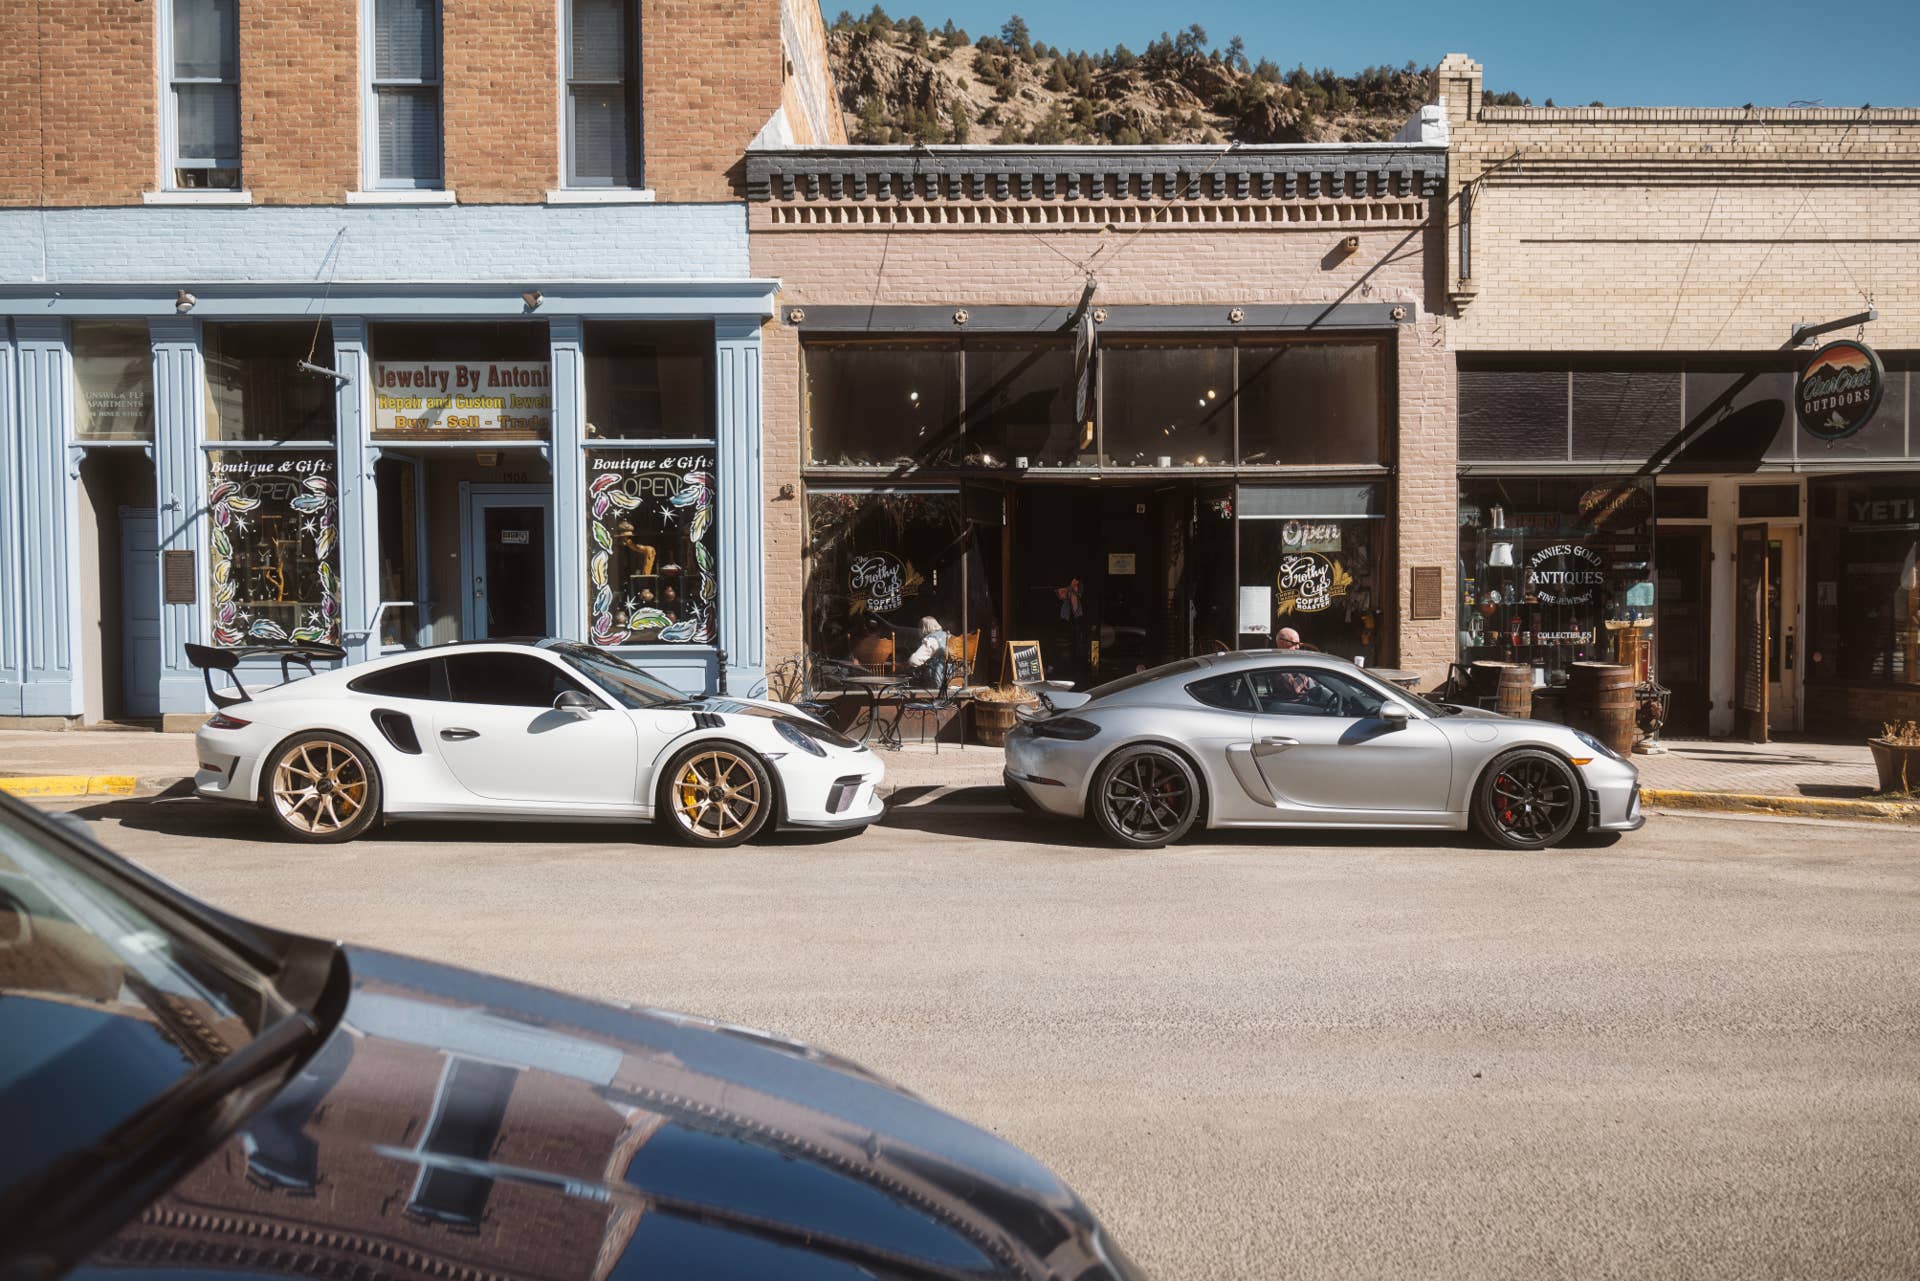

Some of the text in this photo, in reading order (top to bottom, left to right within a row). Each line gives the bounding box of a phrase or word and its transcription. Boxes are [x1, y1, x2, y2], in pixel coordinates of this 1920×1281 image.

[377, 365, 449, 393] Jewelry
[456, 365, 480, 393] By
[378, 394, 422, 411] Repair
[427, 394, 452, 409] and
[456, 395, 506, 409] Custom
[1804, 389, 1871, 414] OUTDOORS
[395, 416, 428, 429] Buy
[447, 416, 480, 428] Sell
[210, 460, 333, 477] Boutique & Gifts
[592, 455, 714, 474] Boutique & Gifts
[241, 482, 301, 500] OPEN
[623, 477, 680, 497] OPEN
[1854, 499, 1914, 521] YETI
[1282, 522, 1341, 546] Open
[1531, 544, 1602, 568] ANNIE'S GOLD
[1280, 556, 1328, 589] Frothy
[1528, 571, 1604, 585] ANTIQUES
[872, 578, 902, 598] Cup
[1300, 578, 1330, 597] Cup
[867, 594, 902, 605] COFFEE
[1295, 594, 1330, 605] COFFEE
[1296, 600, 1330, 610] ROASTER
[1537, 590, 1557, 604] FINE
[1537, 631, 1592, 639] COLLECTIBLES
